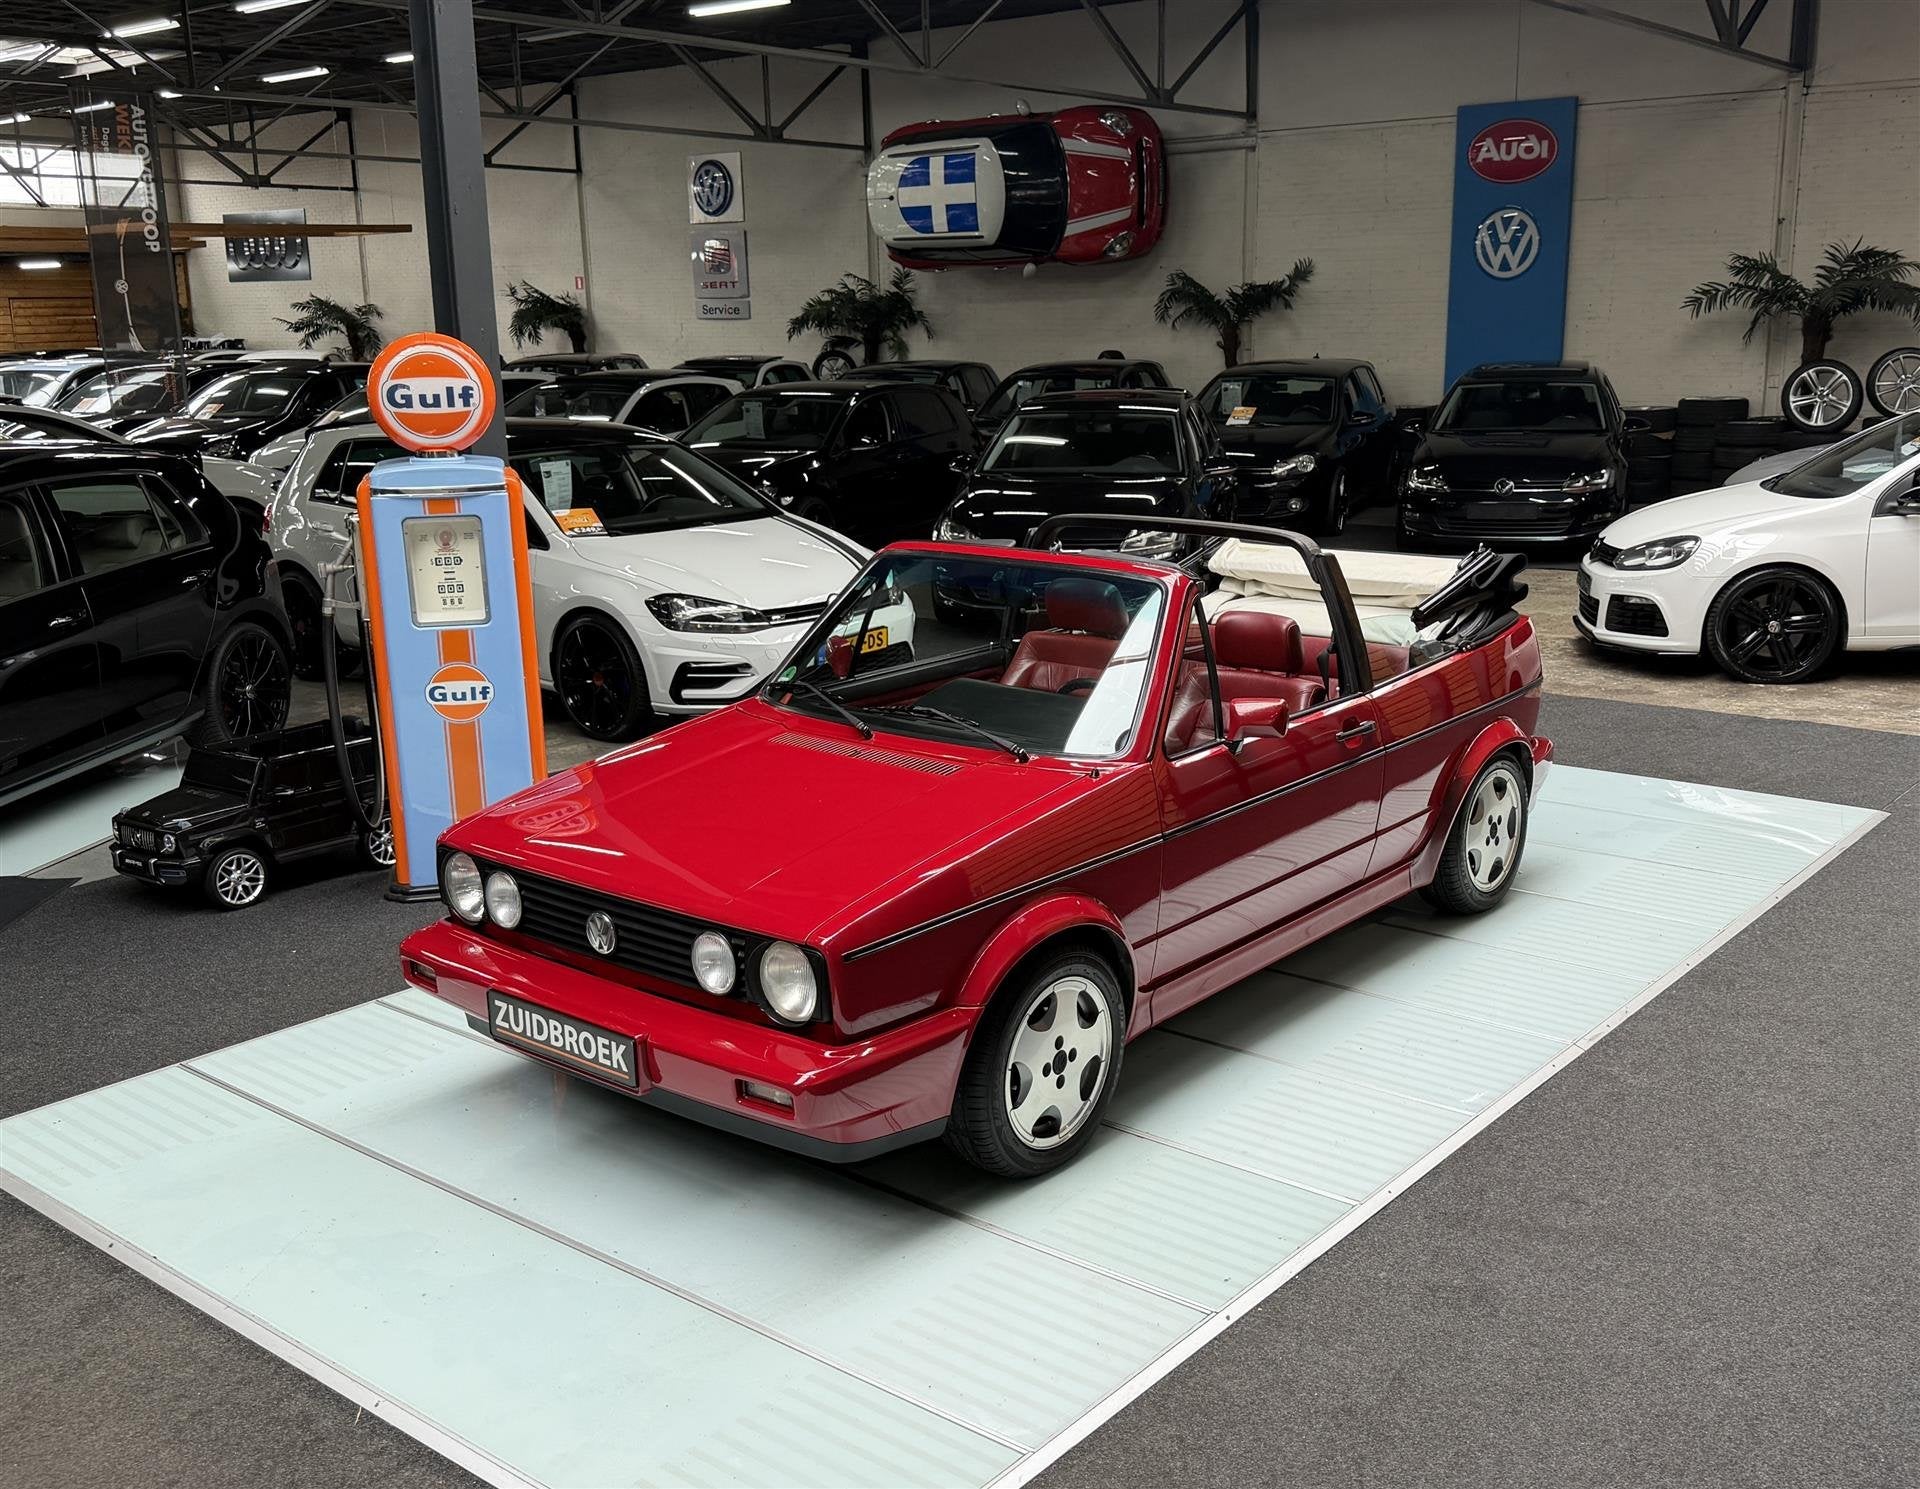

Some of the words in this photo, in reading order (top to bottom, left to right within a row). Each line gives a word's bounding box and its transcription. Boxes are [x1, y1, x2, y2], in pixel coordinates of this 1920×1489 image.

[1475, 134, 1549, 163] Audi
[701, 280, 738, 289] SEAT
[702, 304, 741, 316] Service
[386, 383, 475, 409] Gulf
[428, 685, 490, 702] Gulf
[494, 1000, 629, 1073] ZUIDBROEK
